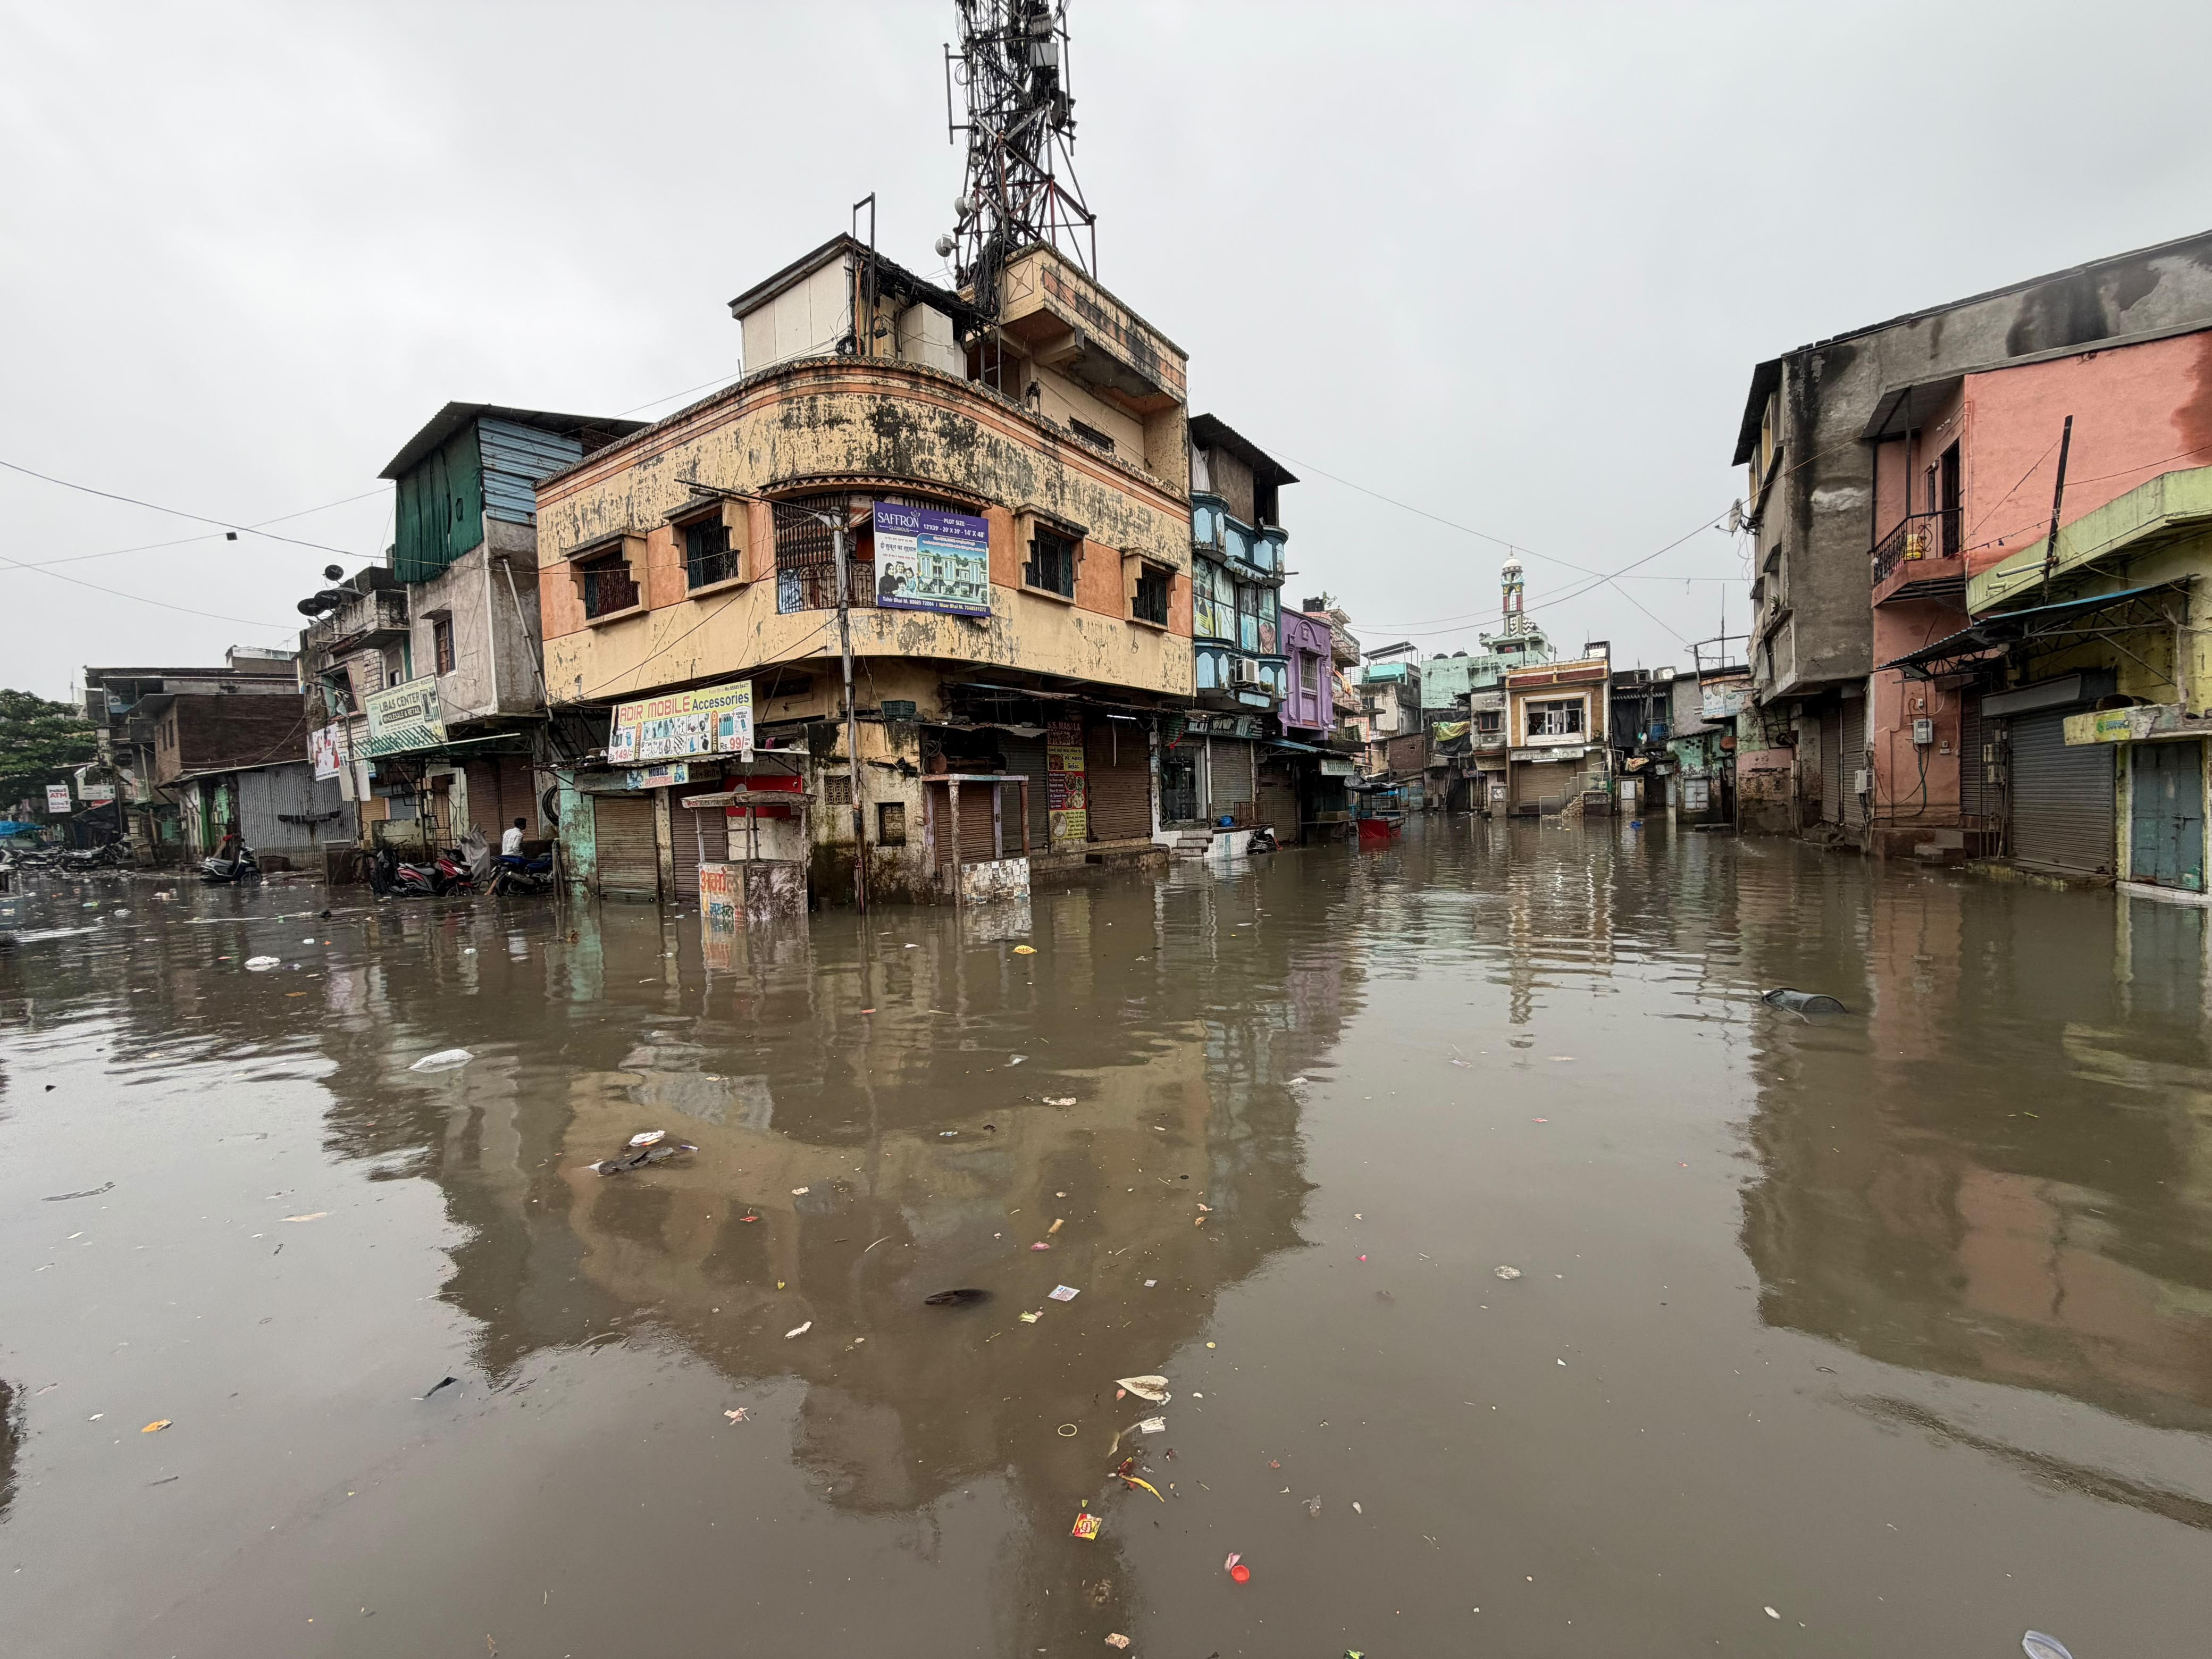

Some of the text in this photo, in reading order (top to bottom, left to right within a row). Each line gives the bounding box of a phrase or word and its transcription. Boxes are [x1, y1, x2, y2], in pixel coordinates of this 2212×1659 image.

[878, 512, 919, 528] SAFFRON
[379, 692, 421, 713] LIBAS CENTER
[618, 691, 749, 722] ADIR MOBILE Accessories
[383, 710, 405, 722] WHOLESALE
[648, 766, 668, 777] MOBILE
